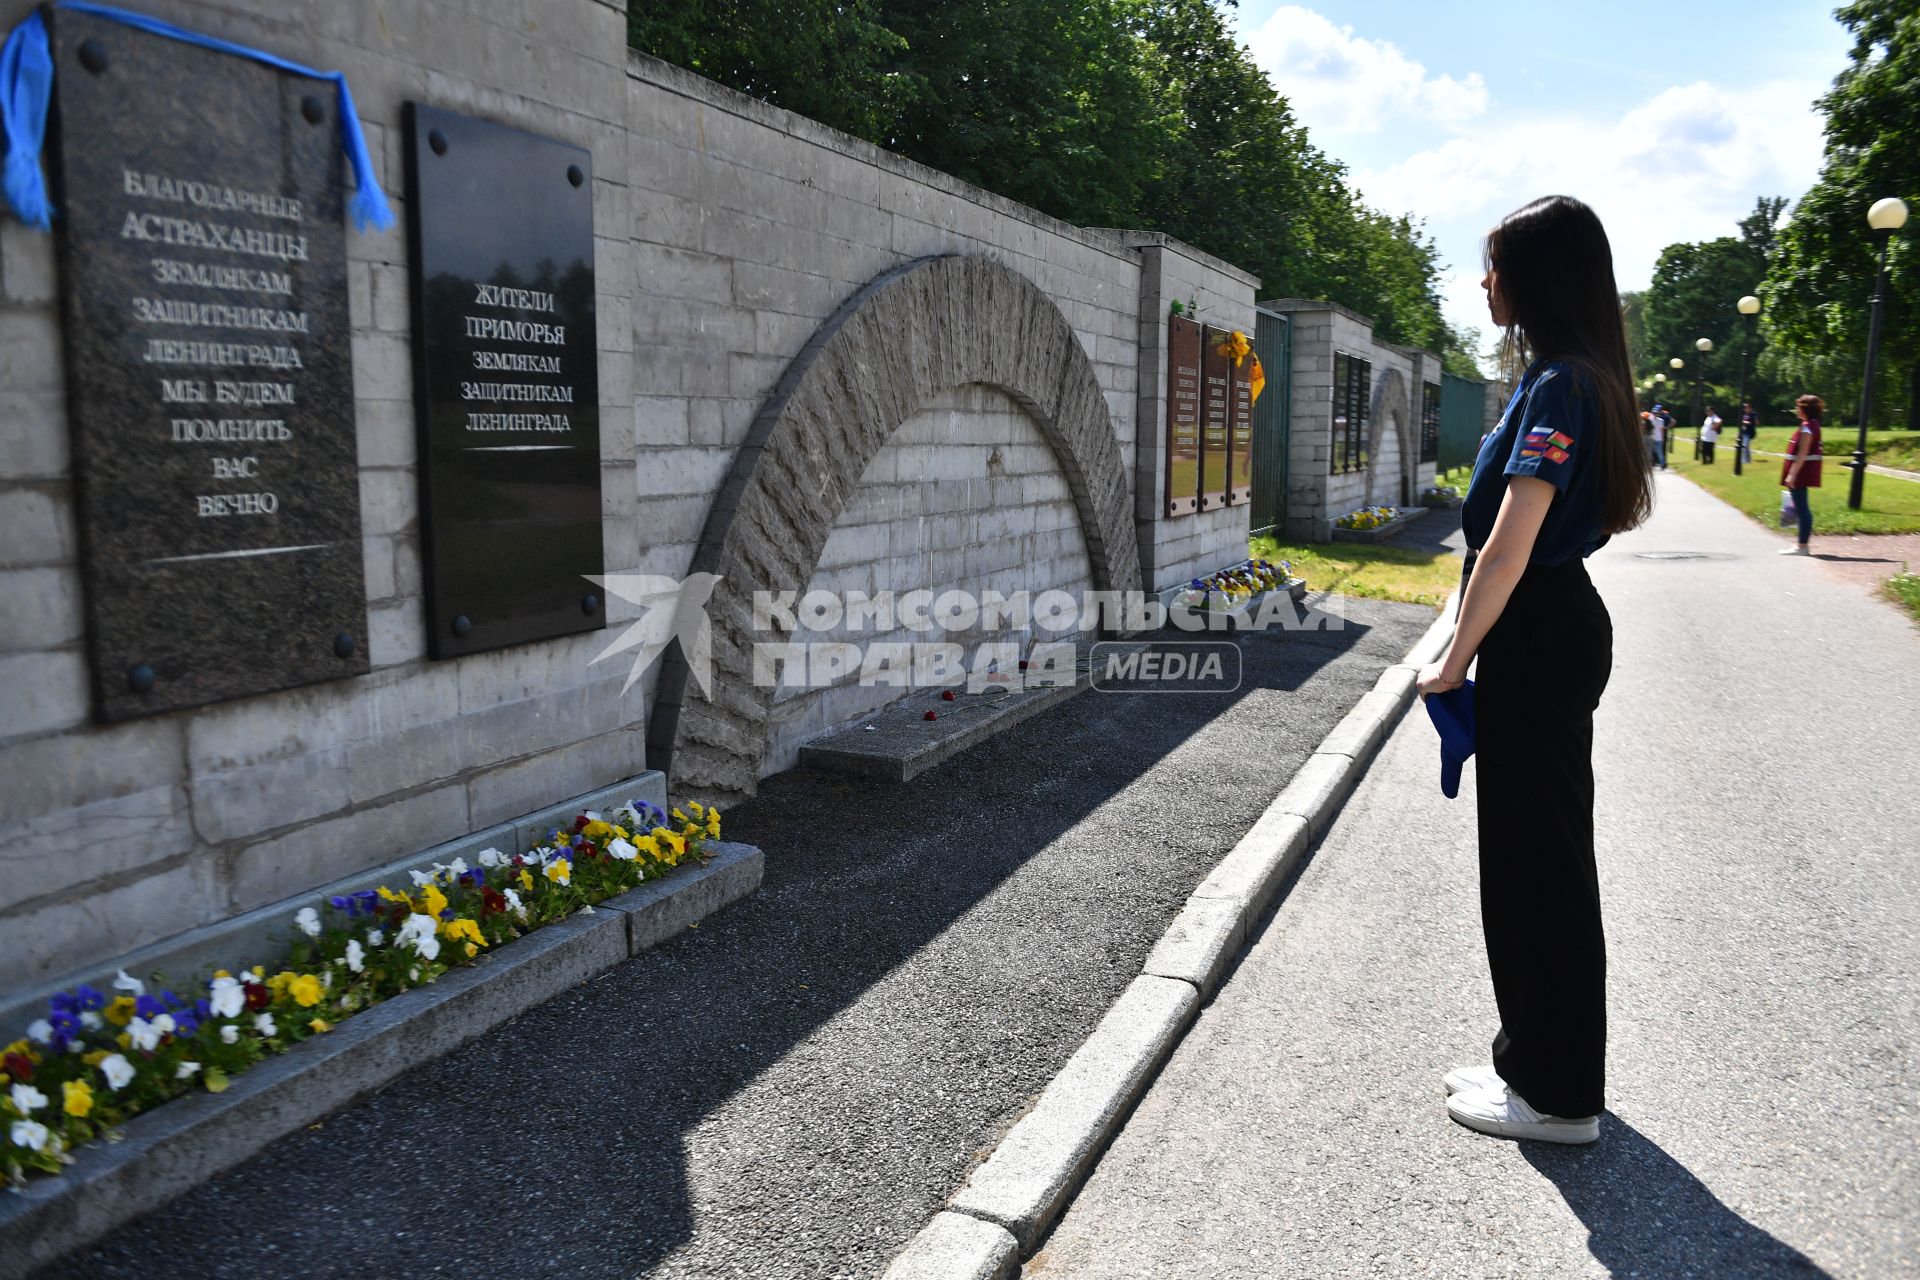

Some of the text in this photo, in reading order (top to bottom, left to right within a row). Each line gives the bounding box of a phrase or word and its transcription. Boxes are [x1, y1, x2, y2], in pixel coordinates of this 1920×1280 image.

[123, 169, 304, 221] БЛАГОДАРНЫЕ
[121, 210, 309, 262] АСТРАХАНЦЫ
[151, 258, 293, 296] ЗЕМЛЯКАМ
[474, 283, 555, 312] ЖИТЕЛИ
[132, 297, 310, 333] ЗАЩИТНИКАМ
[465, 316, 566, 345] ПРИМОРЬЯ
[143, 339, 304, 370] ЛЕНИНГРАДА
[472, 351, 561, 374] ЗЕМЛЯКАМ
[161, 378, 296, 408] МЫ БУДЕМ
[460, 381, 574, 404] ЗАЩИТНИКАМ
[171, 418, 293, 442] ПОМНИТЬ
[465, 412, 572, 433] ЛЕНИНГРАДА
[211, 456, 259, 479] ВАС
[196, 491, 279, 517] ВЕЧНО
